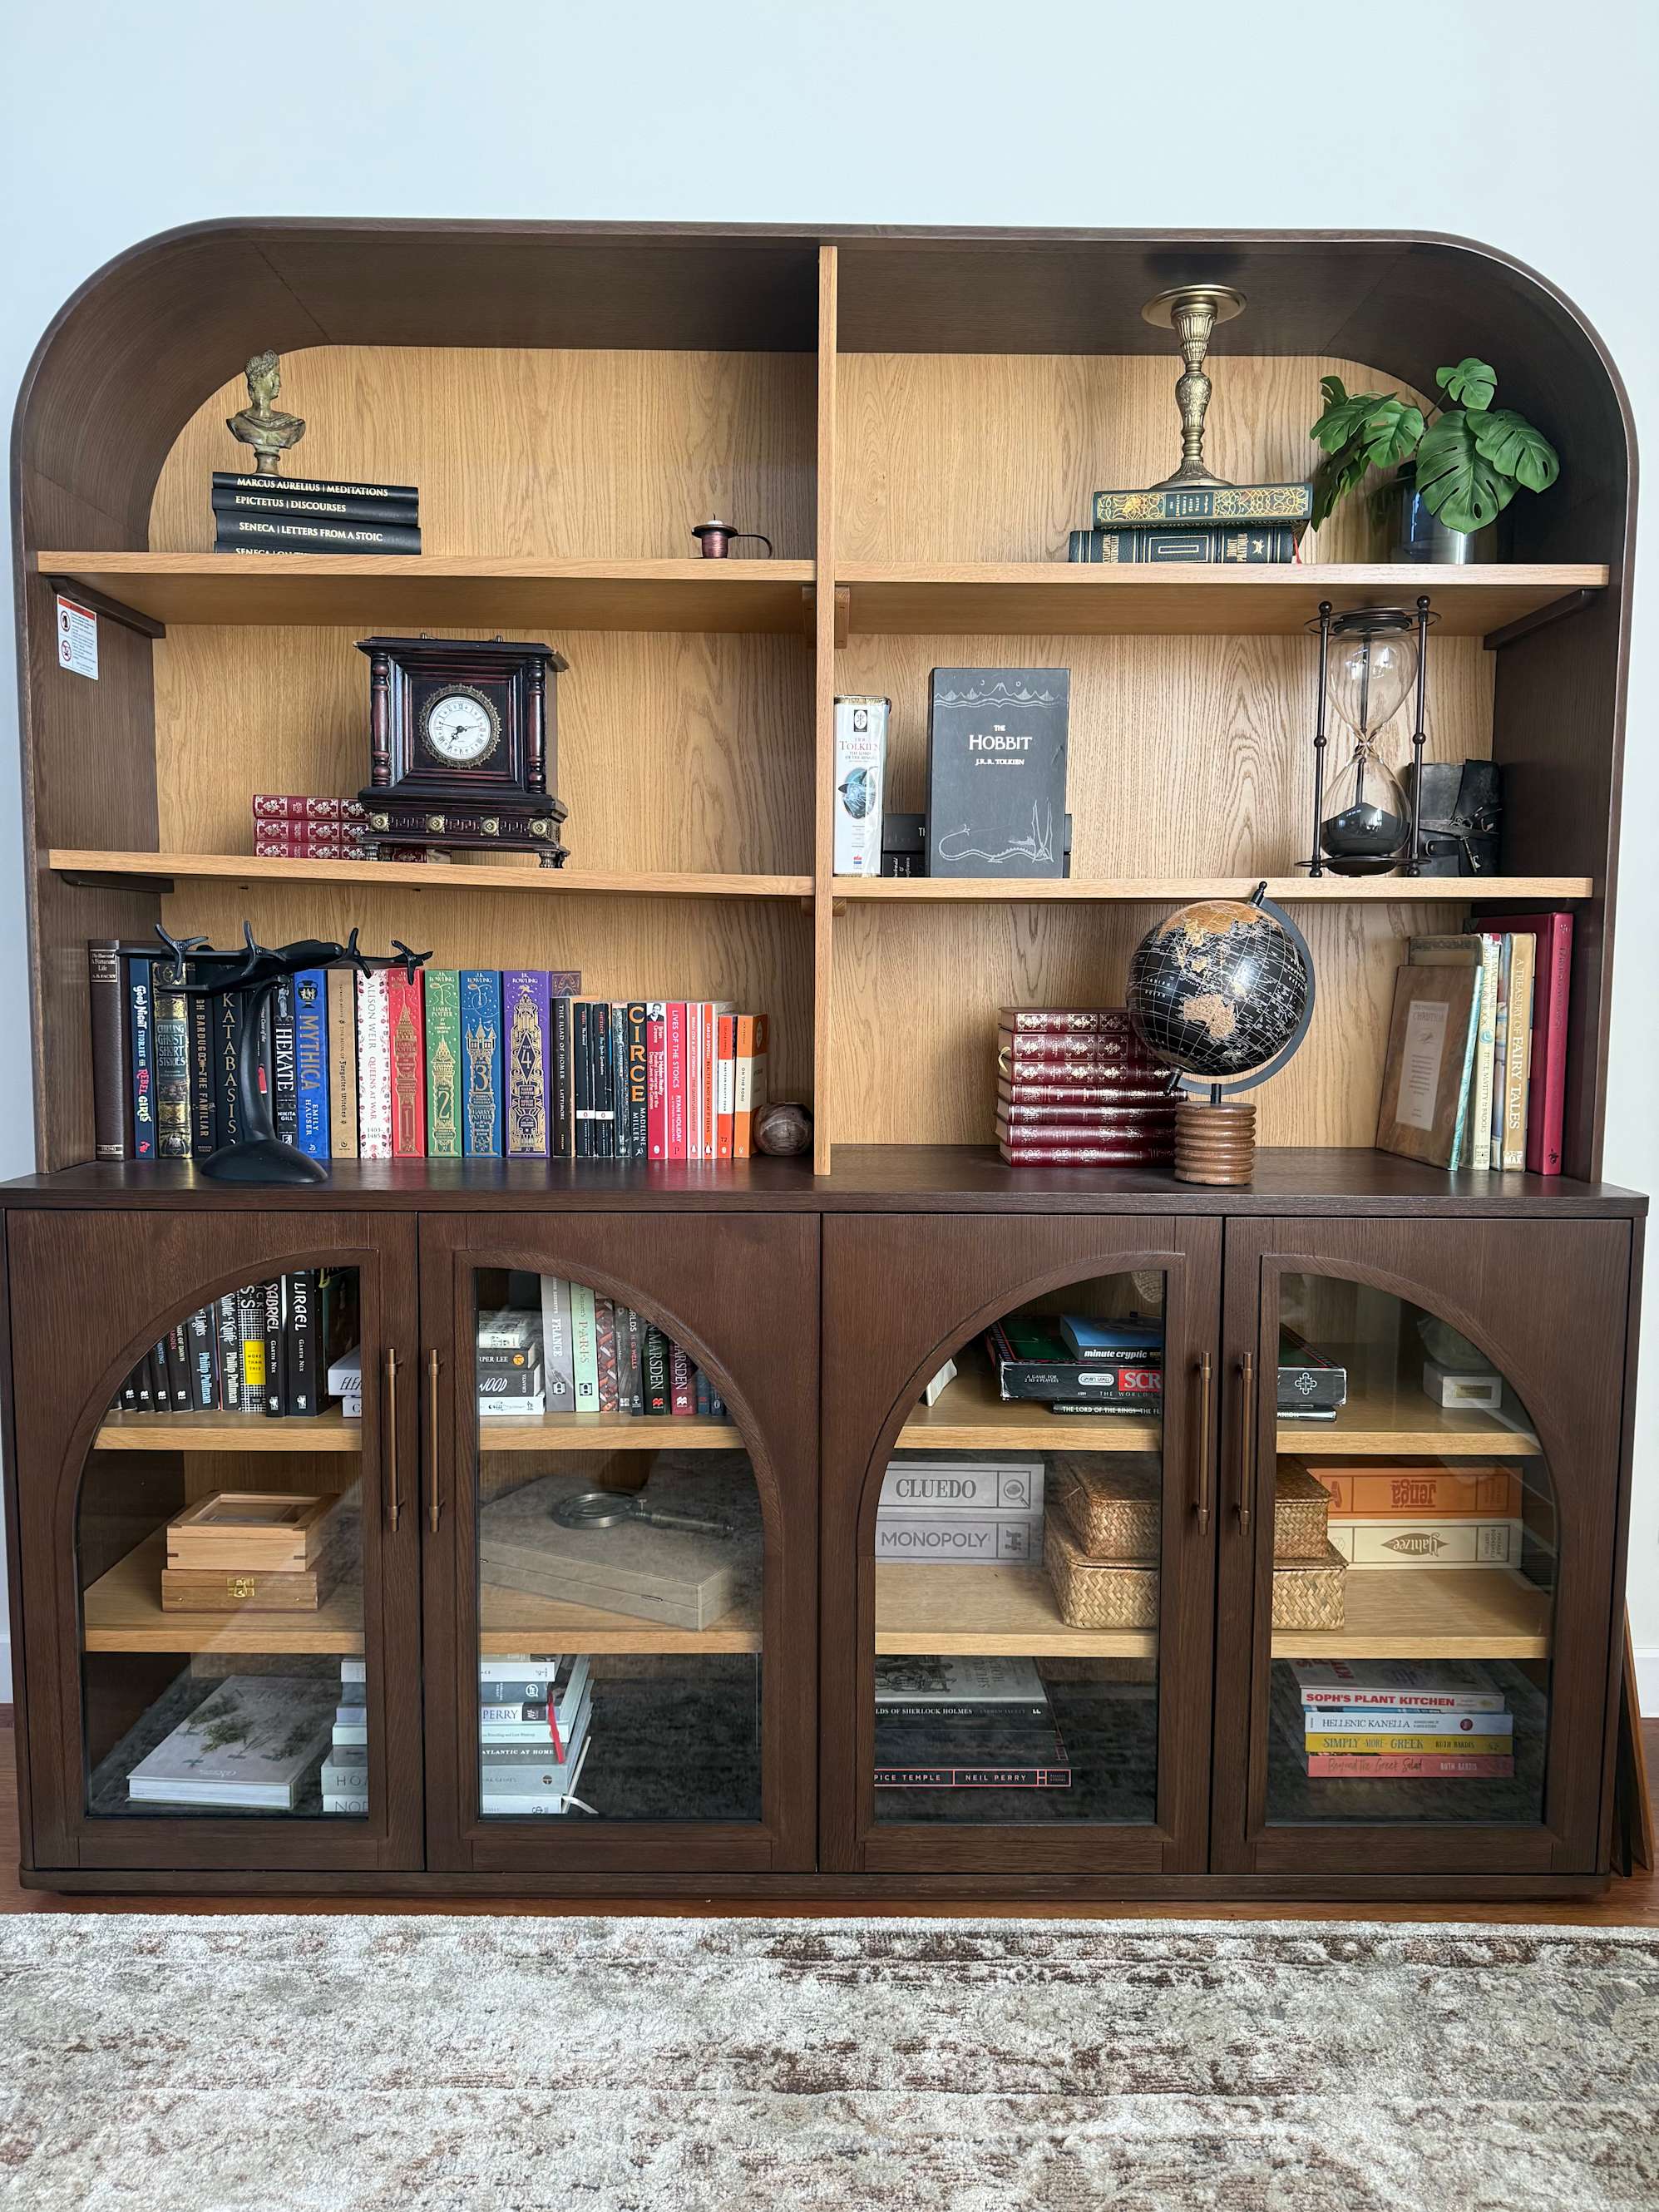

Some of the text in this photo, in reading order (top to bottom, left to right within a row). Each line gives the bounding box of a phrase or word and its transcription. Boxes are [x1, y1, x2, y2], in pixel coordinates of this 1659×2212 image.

[237, 477, 388, 497] MARCUS AURELIUS MEDITATIONS
[235, 496, 346, 512] EPICTETUS DISCOURSES
[239, 521, 383, 541] SENECA LETTERS FROM A STOIC
[1227, 538, 1237, 558] DROIT
[969, 734, 1033, 750] HOBBIT
[368, 982, 376, 1020] ALISON
[1513, 969, 1523, 1020] TREASURY
[157, 1025, 184, 1034] CHILLING
[157, 1034, 185, 1045] GHOST
[368, 1023, 377, 1049] WEIR
[673, 1031, 679, 1043] OF
[1513, 1020, 1522, 1037] OF
[137, 1029, 146, 1057] STORIES
[159, 1045, 185, 1057] SHORT
[299, 1015, 320, 1091] MYTHICA
[559, 1042, 565, 1051] OF
[629, 1006, 646, 1102] CIRCE
[159, 1057, 186, 1066] STORIES
[223, 993, 237, 1134] KATABASIS
[275, 1028, 294, 1091] HEKATE
[521, 1049, 532, 1069] 4
[1512, 1036, 1523, 1079] FAIRY
[136, 1069, 149, 1094] REBEL
[199, 1072, 208, 1089] THE
[368, 1056, 377, 1089] QUEENS
[475, 1064, 489, 1091] 3
[137, 1095, 152, 1123] GIRLS
[199, 1093, 209, 1137] FAMILIAR
[438, 1091, 450, 1119] 2
[1510, 1084, 1522, 1129] TALES
[264, 1282, 279, 1332] SABRIEL
[293, 1282, 307, 1331] LIRAEL
[177, 1337, 184, 1345] OF
[220, 1293, 239, 1404] Subtle Knife Philip Pullman
[551, 1318, 563, 1357] FRANCE
[192, 1315, 212, 1405] Lights Philip Pullman
[649, 1334, 664, 1390] MARSDEN
[1084, 1349, 1148, 1360] minute cryptic
[896, 1479, 977, 1498] CLUEDO
[1391, 1479, 1437, 1507] Jenga
[881, 1532, 988, 1548] MONOPOLY
[1390, 1532, 1440, 1558] Yahtzee
[1306, 1693, 1455, 1706] SOPH'S PLANT KITCHEN
[482, 1709, 518, 1720] PERRY
[1322, 1718, 1366, 1728] HELLENIC
[1368, 1719, 1410, 1728] KANELLA
[1323, 1738, 1358, 1748] SIMPLY
[1390, 1739, 1424, 1749] GREEK
[1439, 1762, 1455, 1770] RUTH
